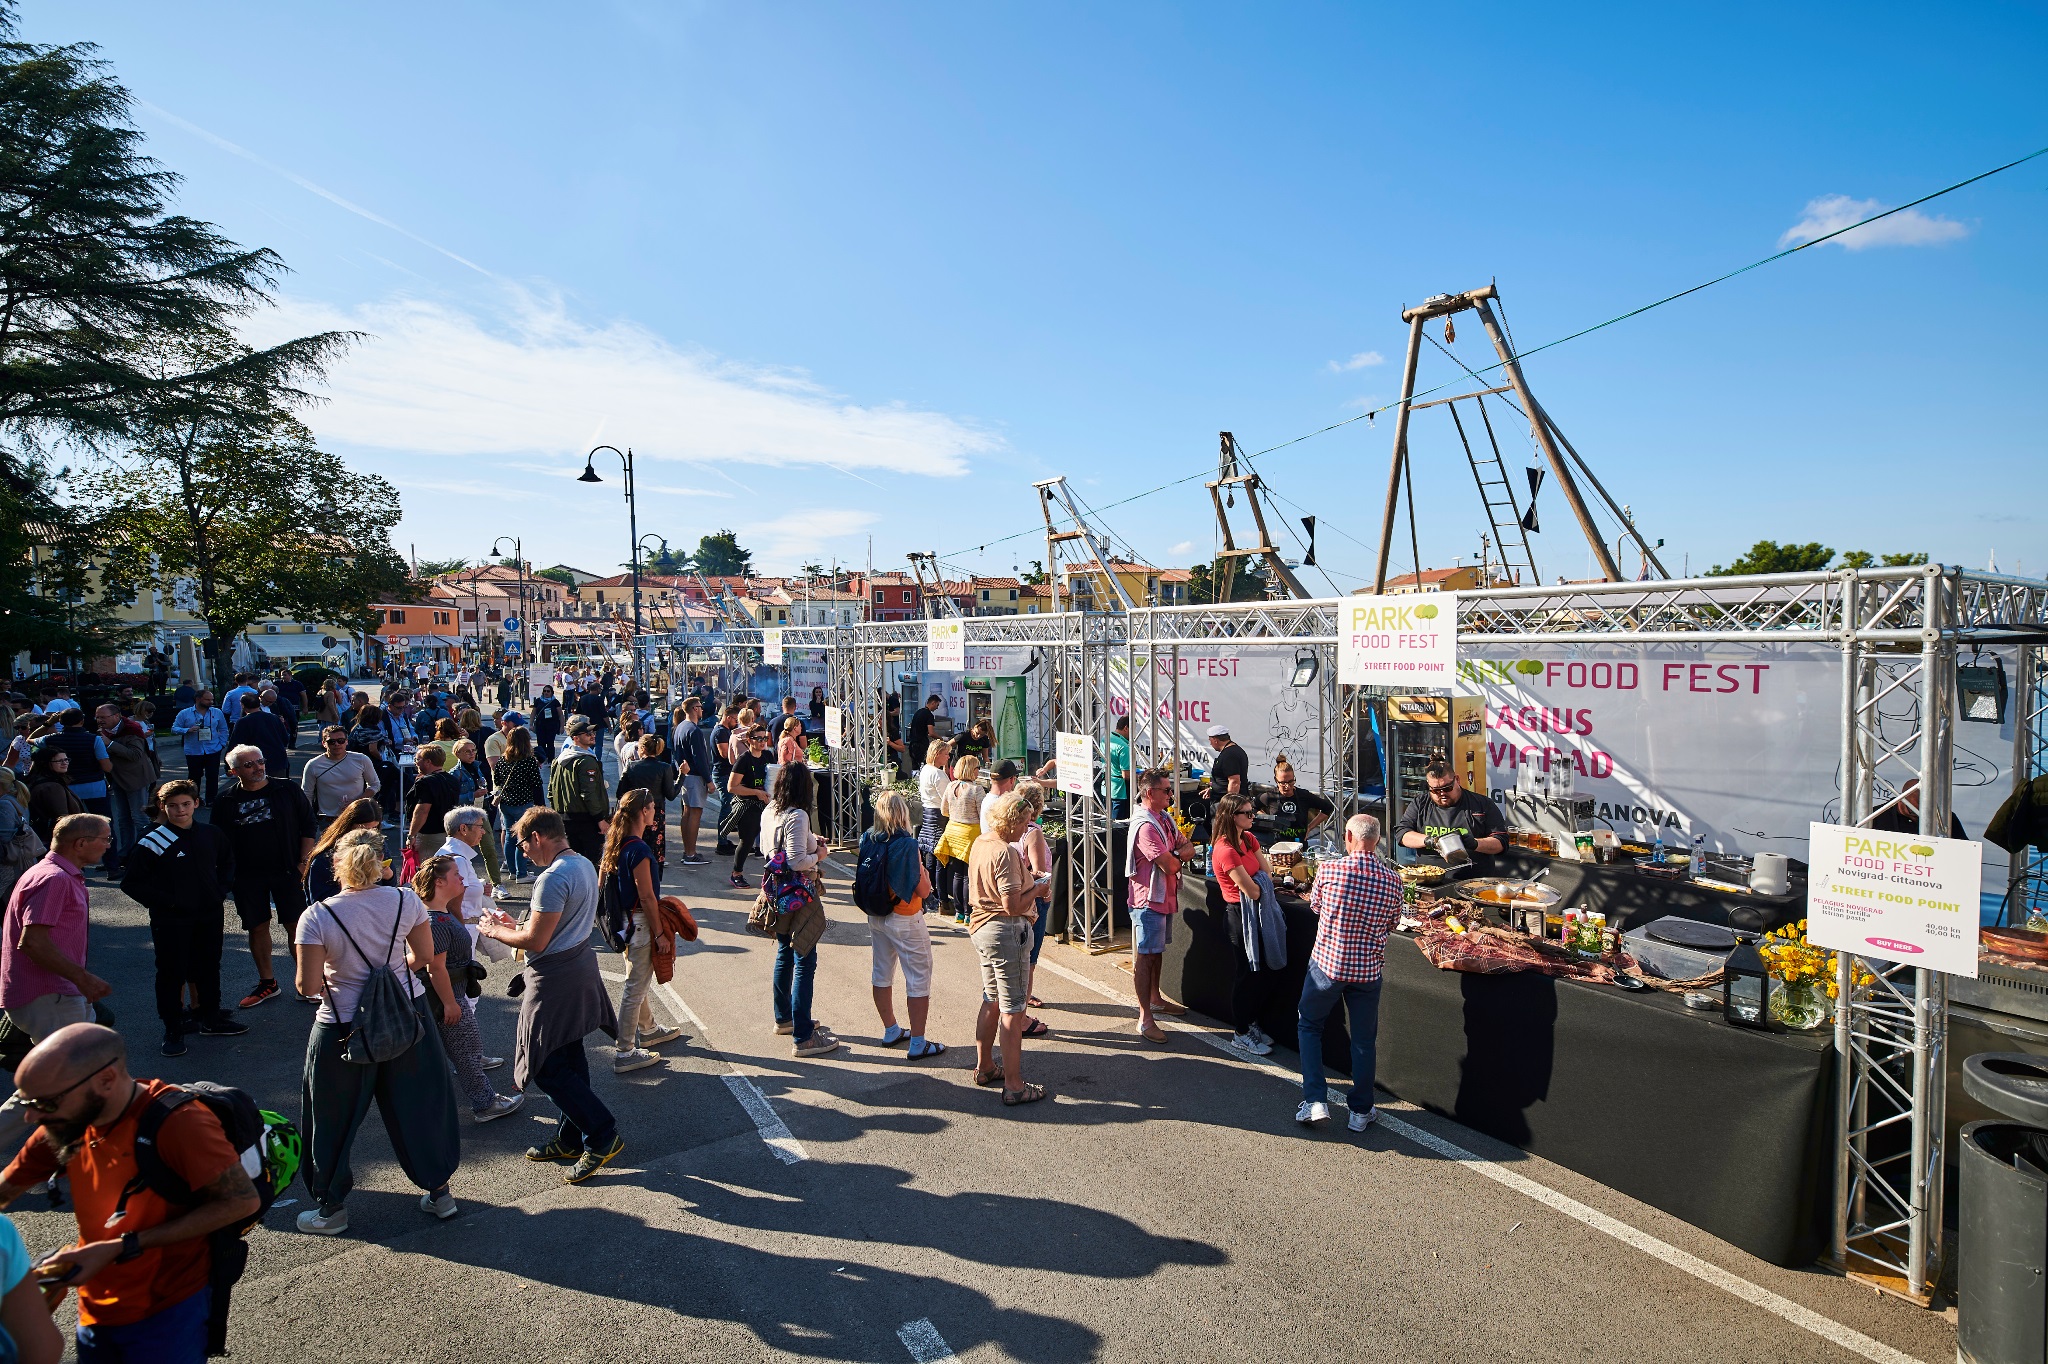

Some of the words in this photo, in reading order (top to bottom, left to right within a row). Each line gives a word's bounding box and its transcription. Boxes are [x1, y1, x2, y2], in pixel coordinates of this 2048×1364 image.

[1352, 605, 1413, 631] PARK
[931, 625, 951, 640] PARK
[931, 641, 945, 650] FOOD
[946, 641, 959, 650] FEST
[1352, 634, 1390, 649] FOOD
[1399, 633, 1439, 649] FEST
[980, 656, 1003, 670] FEST
[1197, 658, 1240, 677] FEST
[1364, 662, 1391, 671] STREET
[1393, 662, 1416, 671] FOOD
[1418, 662, 1445, 672] POINT
[1546, 662, 1639, 690] FOOD
[1662, 663, 1770, 695] FEST
[1594, 801, 1684, 830] ANOVA
[1844, 836, 1909, 862] PARK
[1844, 855, 1885, 871] FOOD
[1893, 862, 1935, 878] FEST
[1813, 897, 1845, 908] PELAGIUS
[1846, 903, 1884, 915] NOVIGRAD
[1831, 884, 1875, 899] STREET
[1878, 892, 1914, 905] FOOD
[1918, 898, 1961, 913] POINT
[1822, 910, 1845, 919] Istrian
[1846, 913, 1866, 922] pasta
[1846, 908, 1871, 918] tortilla
[1925, 923, 1948, 932] 40,00
[1950, 926, 1961, 934] kn
[1925, 928, 1948, 938] 40,00
[1950, 932, 1961, 940] kn
[1876, 939, 1892, 947] BUY
[1893, 943, 1913, 952] HERE
